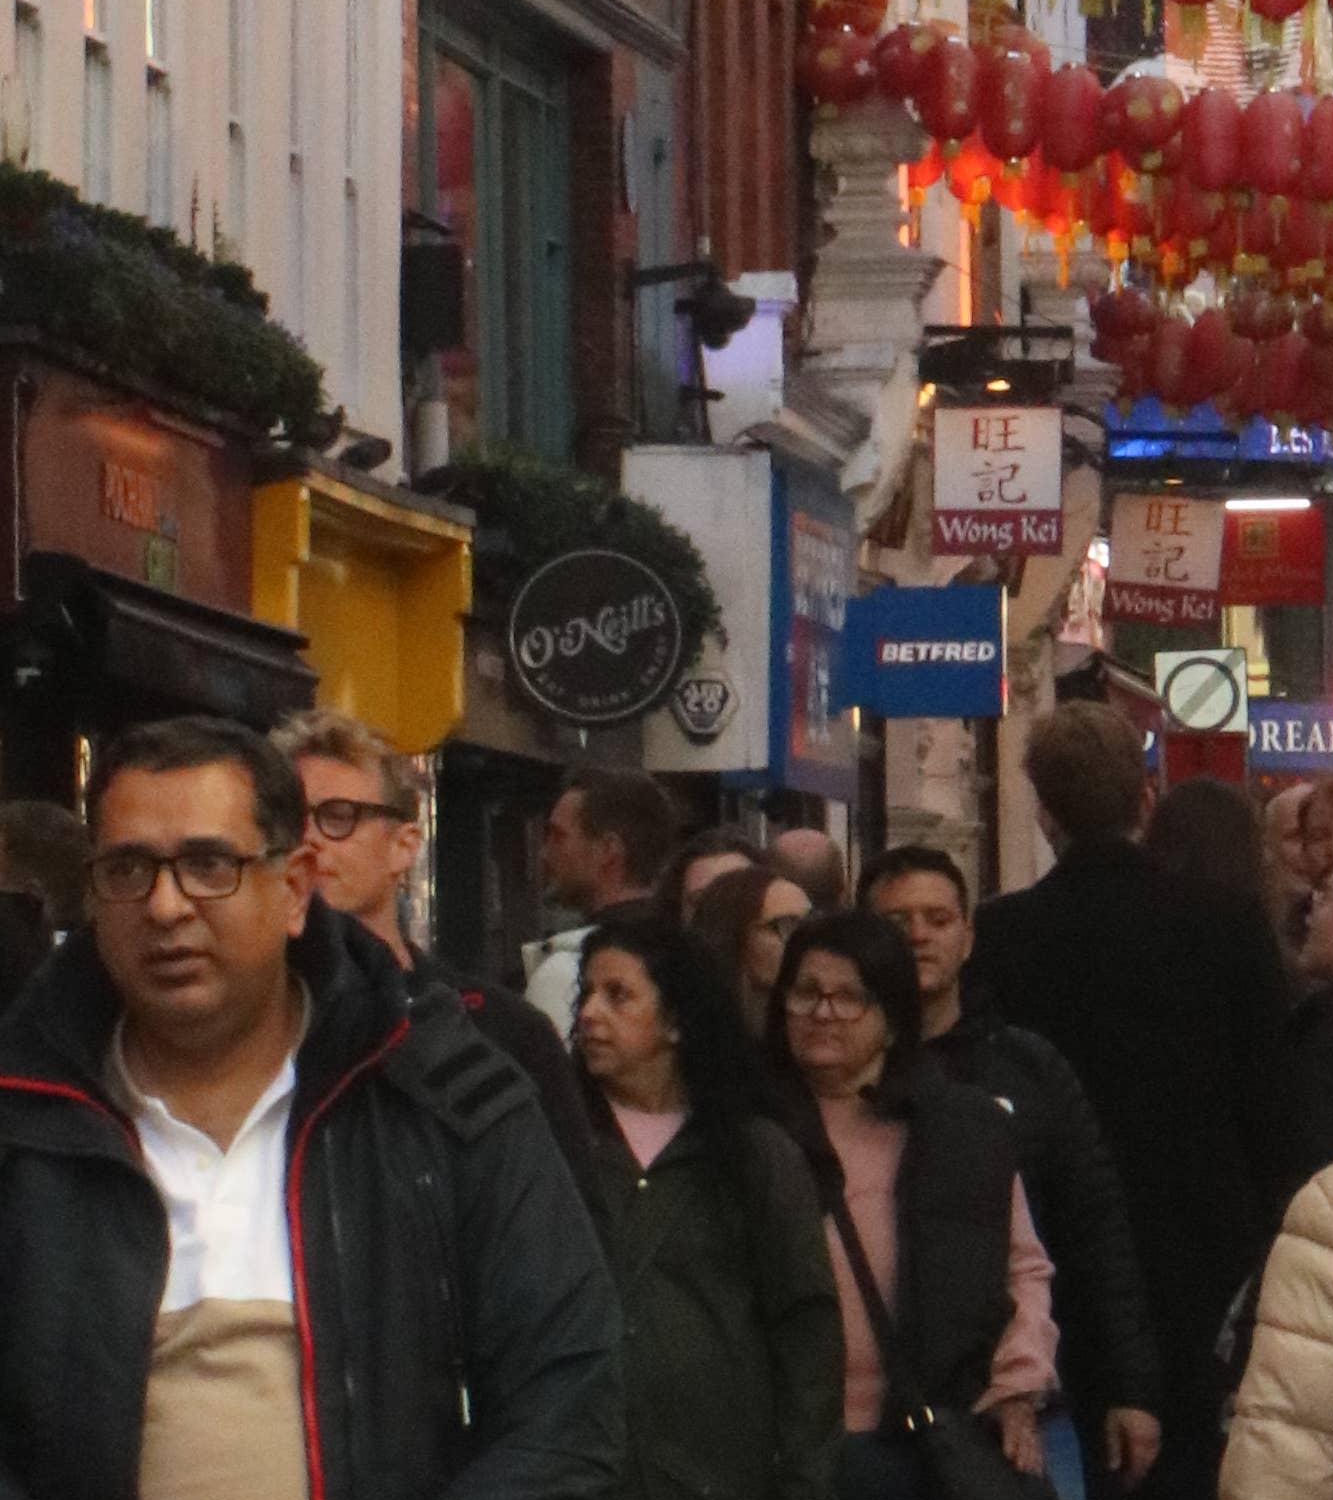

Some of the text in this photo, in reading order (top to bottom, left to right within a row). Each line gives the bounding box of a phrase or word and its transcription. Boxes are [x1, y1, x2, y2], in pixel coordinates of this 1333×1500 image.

[938, 513, 1058, 551] Wong Kei
[1110, 588, 1215, 623] Wong Kei
[880, 642, 997, 664] BETFRED
